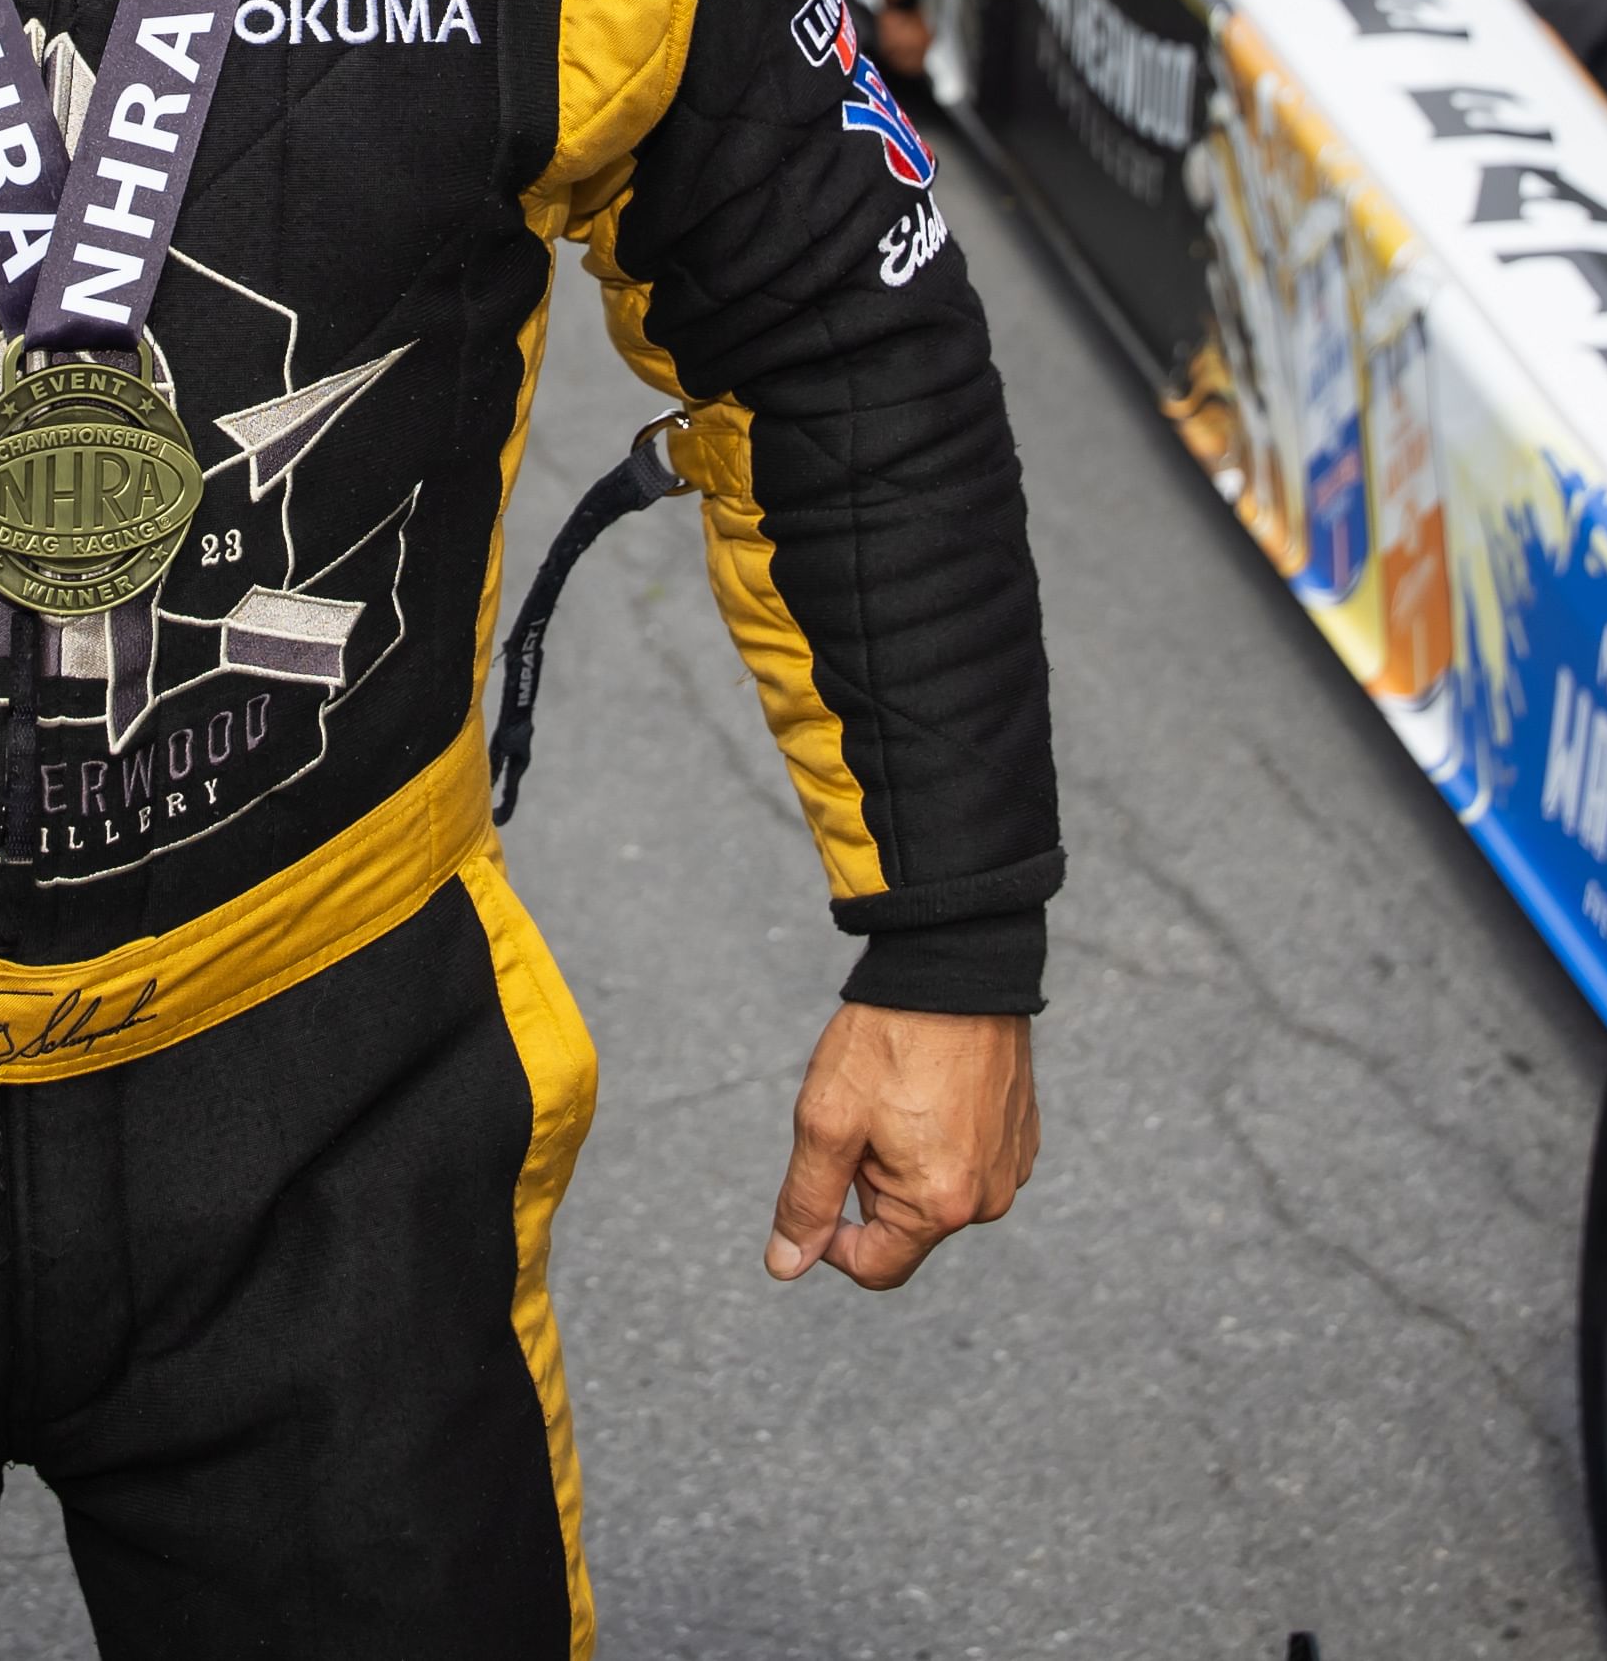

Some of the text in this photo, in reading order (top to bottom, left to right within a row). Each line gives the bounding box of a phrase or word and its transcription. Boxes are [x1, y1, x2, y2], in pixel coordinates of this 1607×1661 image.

[60, 10, 215, 323] NHRA
[30, 372, 127, 400] EVENT
[73, 521, 156, 555] RACING
[201, 529, 243, 565] 23
[22, 575, 135, 607] WINNER
